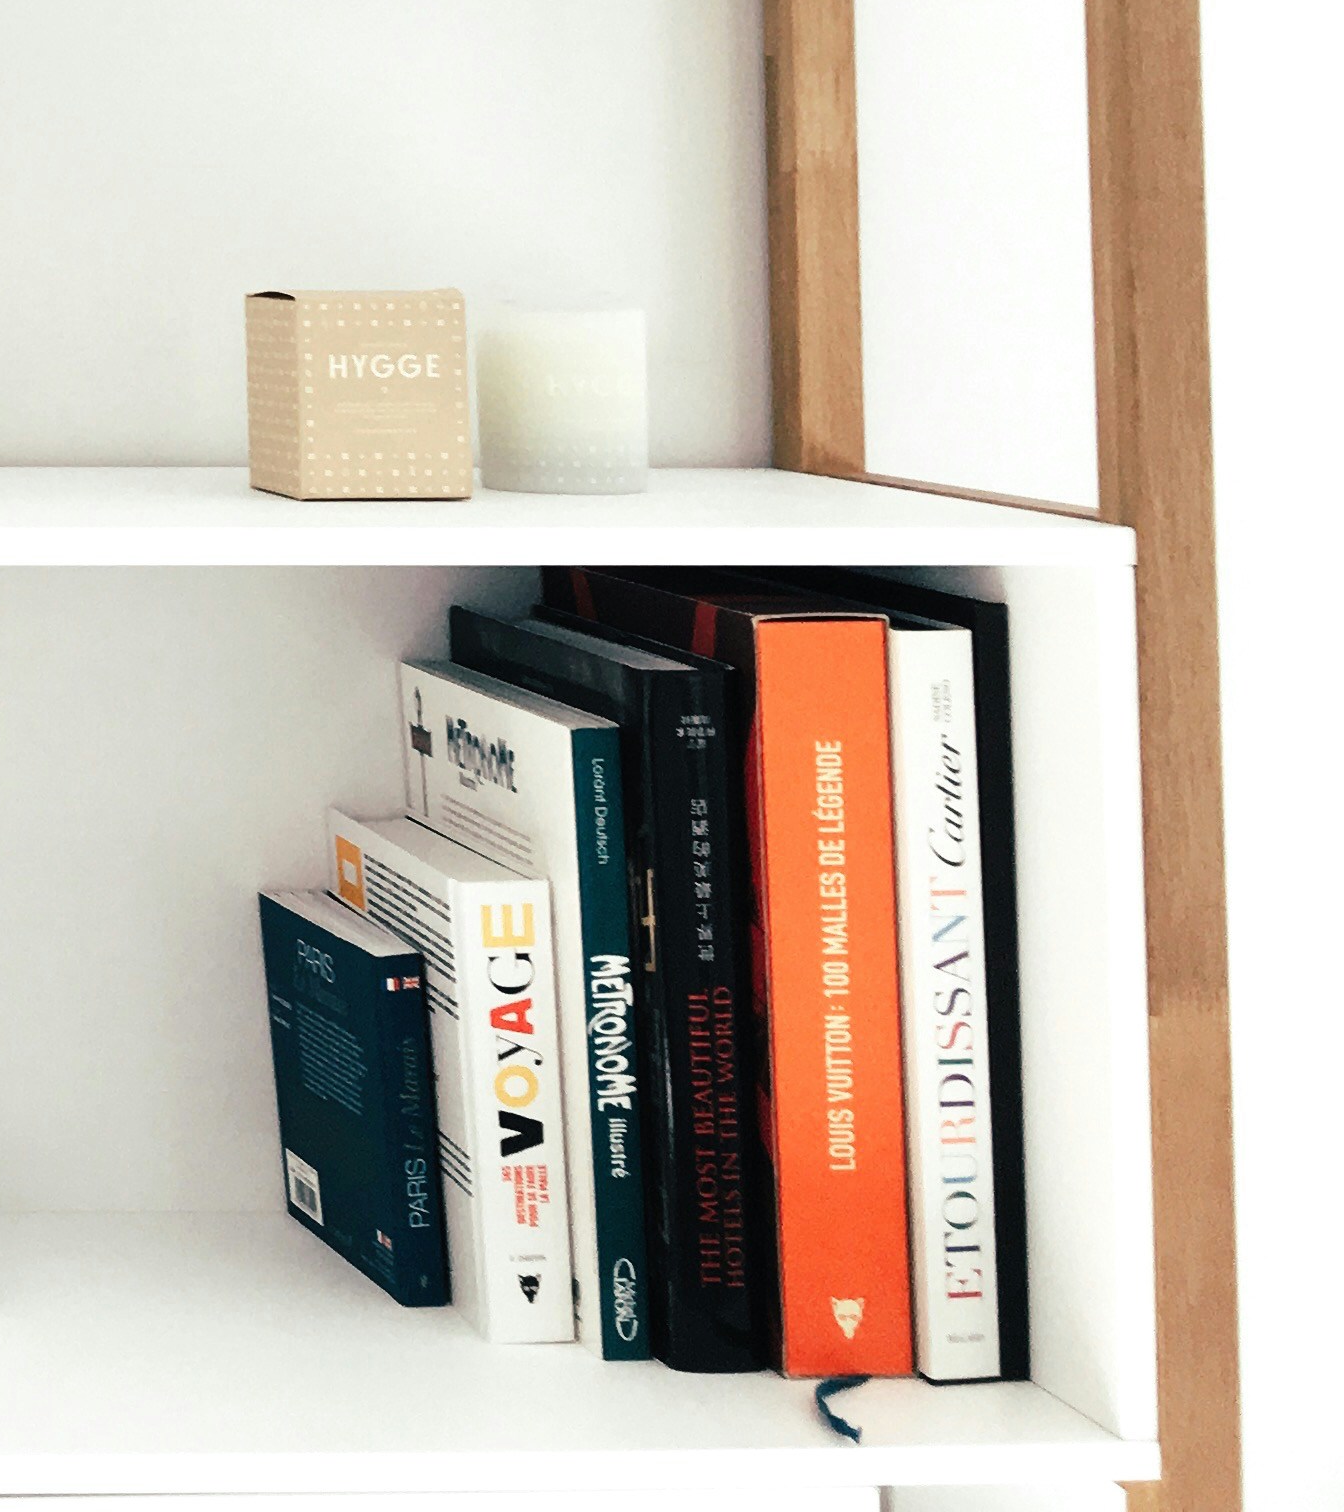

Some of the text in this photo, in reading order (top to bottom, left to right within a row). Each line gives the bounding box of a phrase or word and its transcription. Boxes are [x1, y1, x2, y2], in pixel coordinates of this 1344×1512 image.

[328, 353, 441, 379] HYGGE
[812, 740, 844, 833] LÉGENDE
[928, 732, 966, 867] Cartier
[593, 805, 611, 866] Deutsch
[818, 839, 845, 865] DE
[820, 872, 849, 954] MALLES
[822, 962, 850, 998] 100
[930, 876, 983, 1301] ETOURDISSANT
[608, 1118, 631, 1178] illustré
[687, 987, 721, 1288] THE MOST BEAUTIFUL
[712, 986, 745, 1288] HOTELS IN THE WORLD
[828, 1109, 857, 1171] LOUIS
[405, 1158, 431, 1228] PARIS
